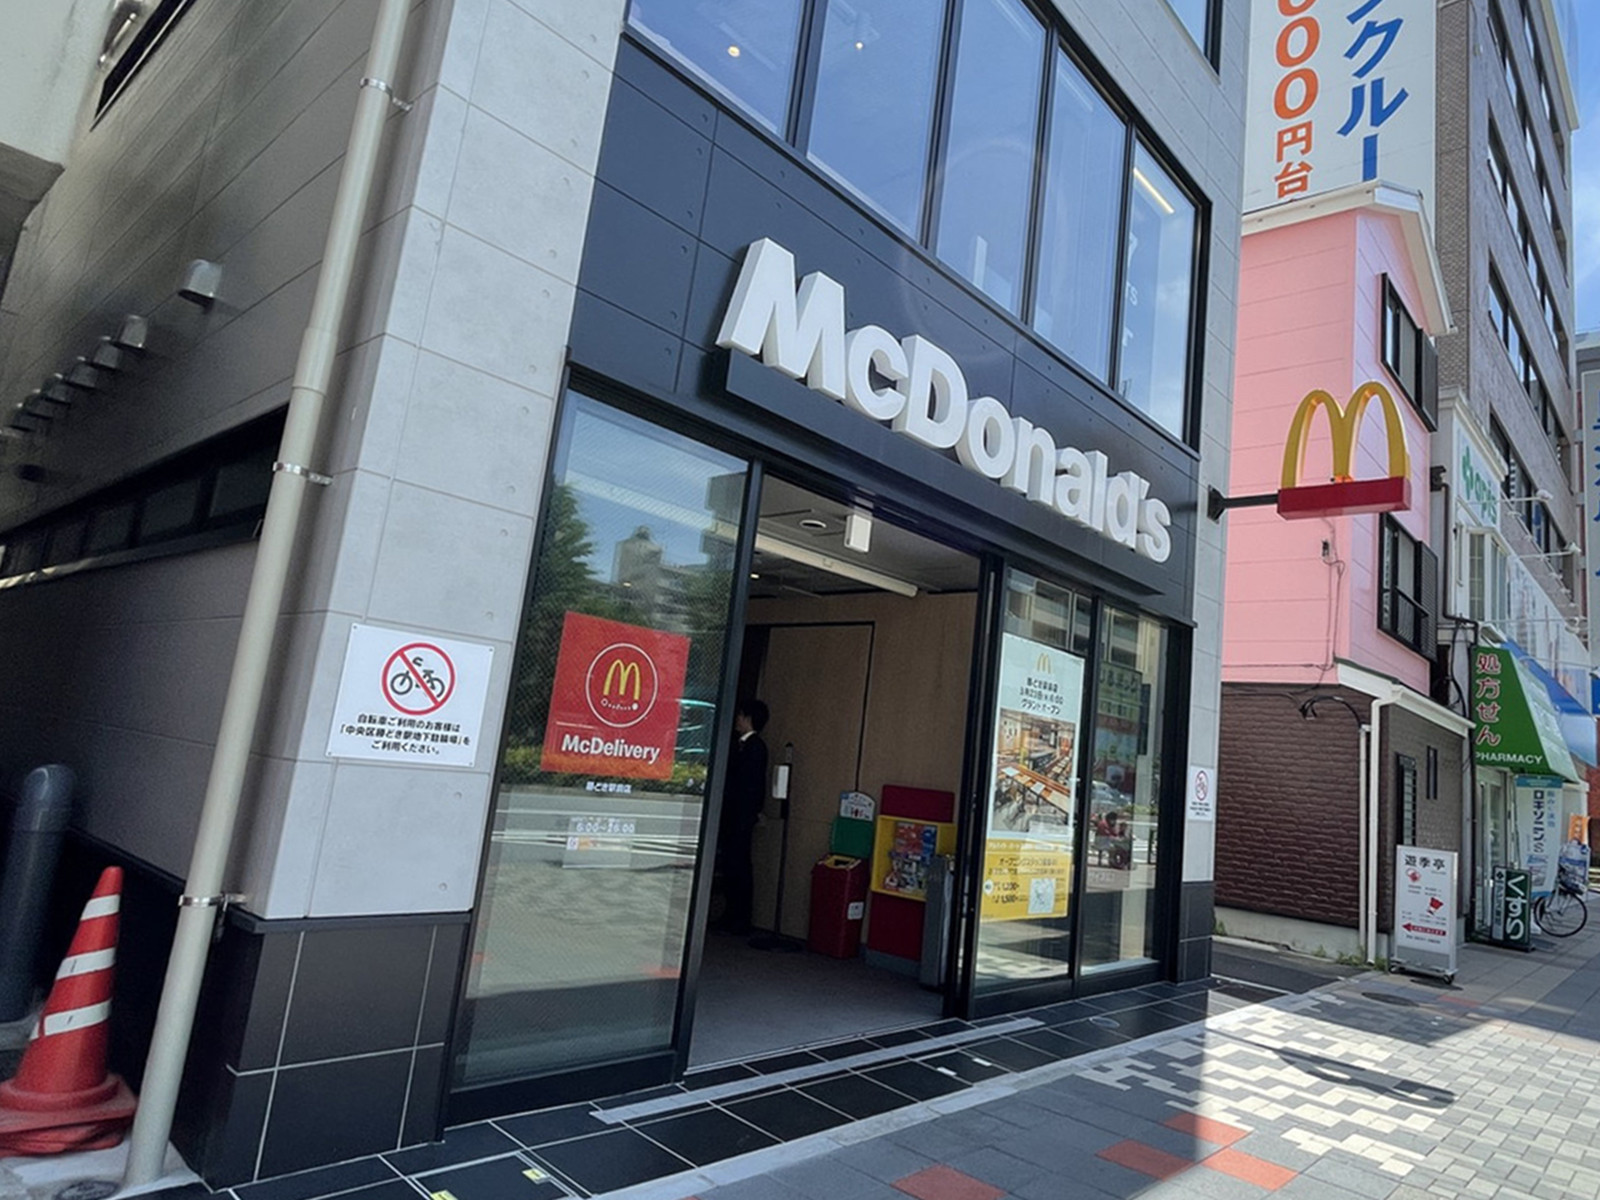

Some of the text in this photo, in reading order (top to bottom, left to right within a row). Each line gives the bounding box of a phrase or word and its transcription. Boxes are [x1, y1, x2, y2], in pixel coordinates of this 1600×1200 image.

[716, 237, 1172, 563] McDonald's
[1475, 652, 1501, 746] 処方せん
[561, 734, 660, 765] McDelivery
